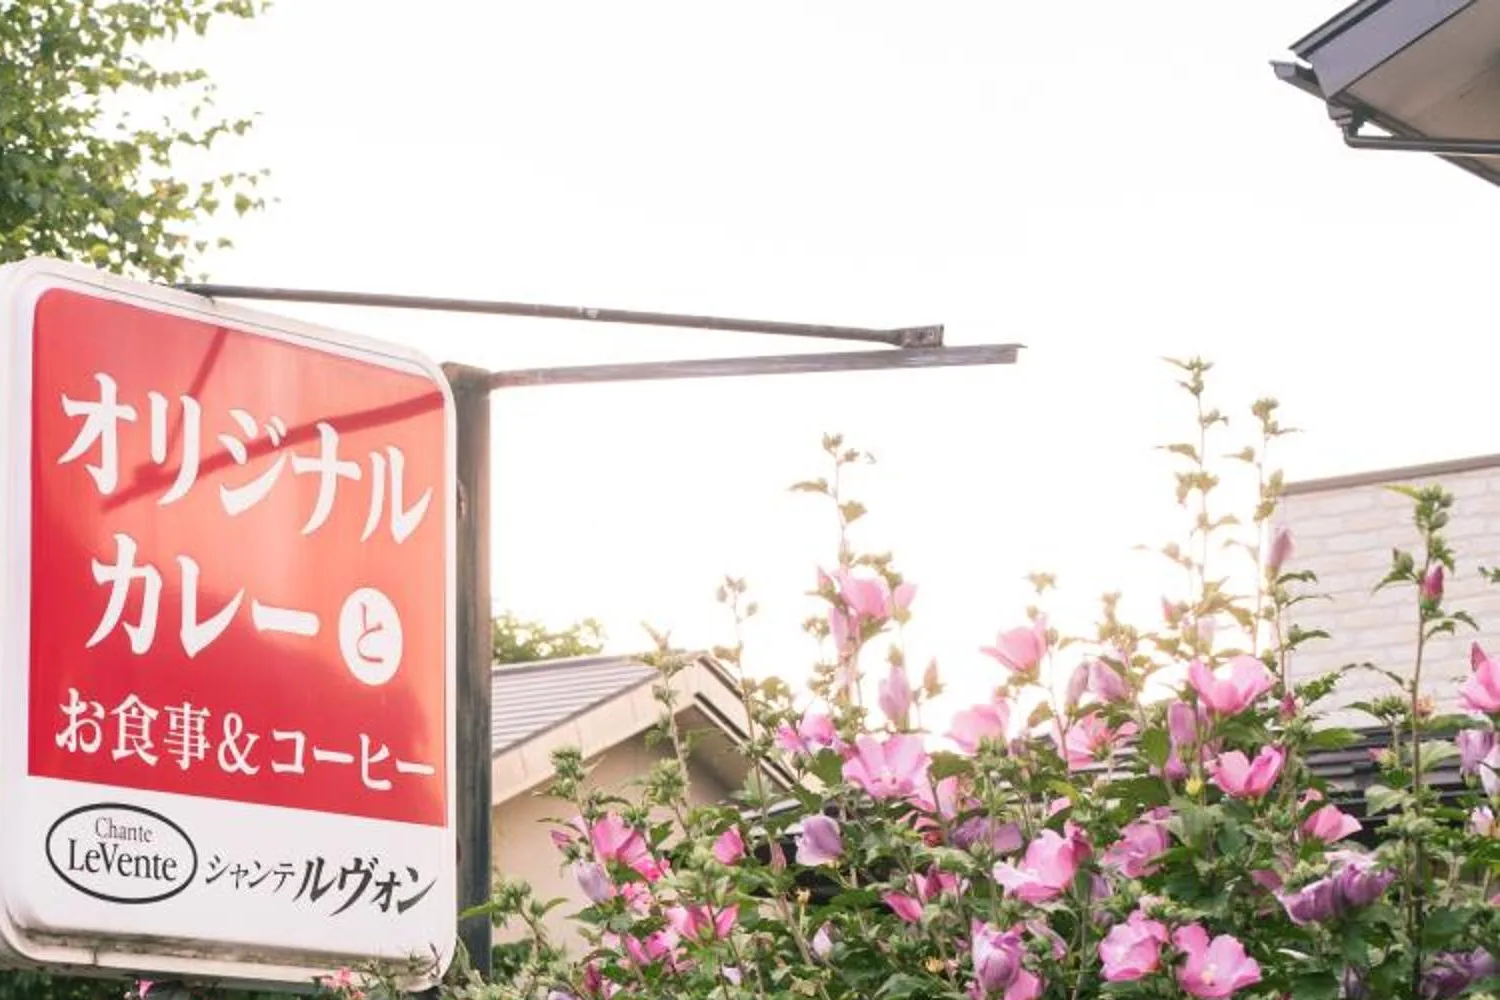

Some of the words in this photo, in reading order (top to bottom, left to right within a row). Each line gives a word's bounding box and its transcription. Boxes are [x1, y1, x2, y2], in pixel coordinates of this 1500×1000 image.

[58, 372, 432, 543] オリジナル
[55, 688, 435, 790] お食事&コーヒー
[67, 838, 178, 881] LeVente
[95, 817, 153, 844] Chante
